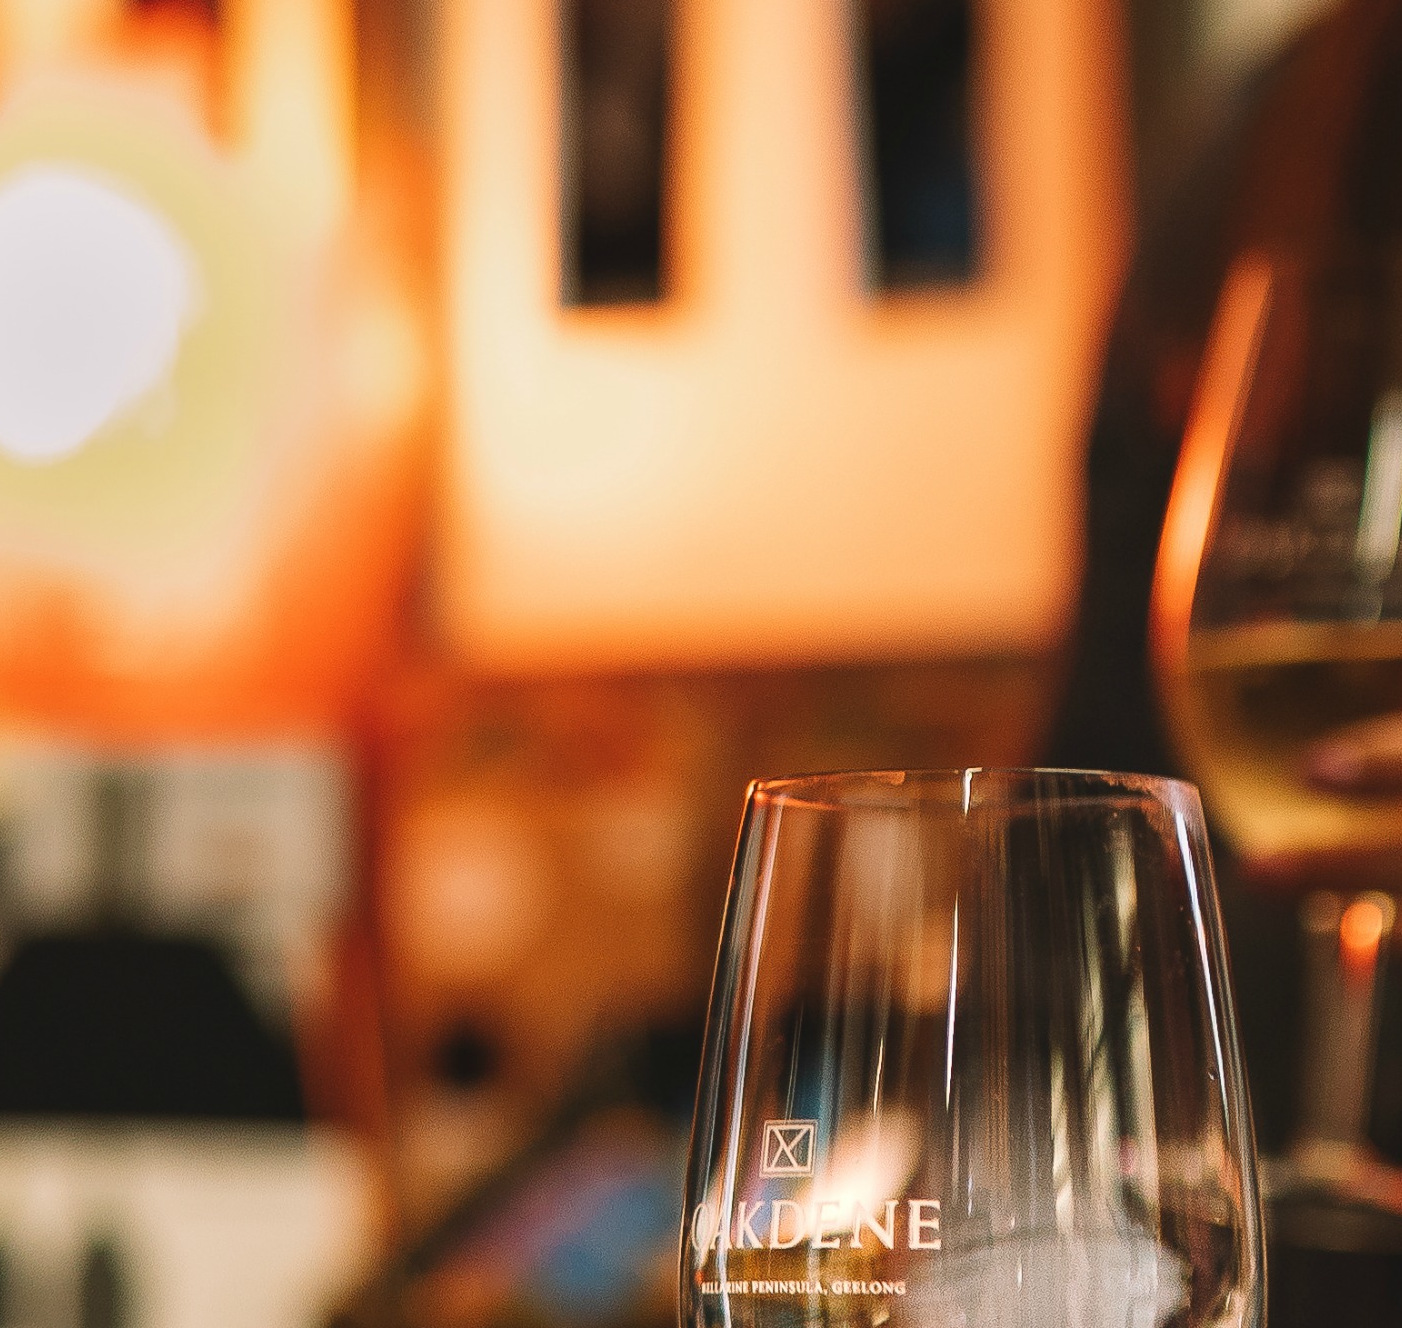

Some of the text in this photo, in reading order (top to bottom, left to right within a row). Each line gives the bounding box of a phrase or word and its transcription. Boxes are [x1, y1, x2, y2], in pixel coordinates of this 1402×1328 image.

[692, 1197, 942, 1251] OAKDENE
[752, 1280, 828, 1296] PENINSULA,
[831, 1280, 906, 1296] GEELONG
